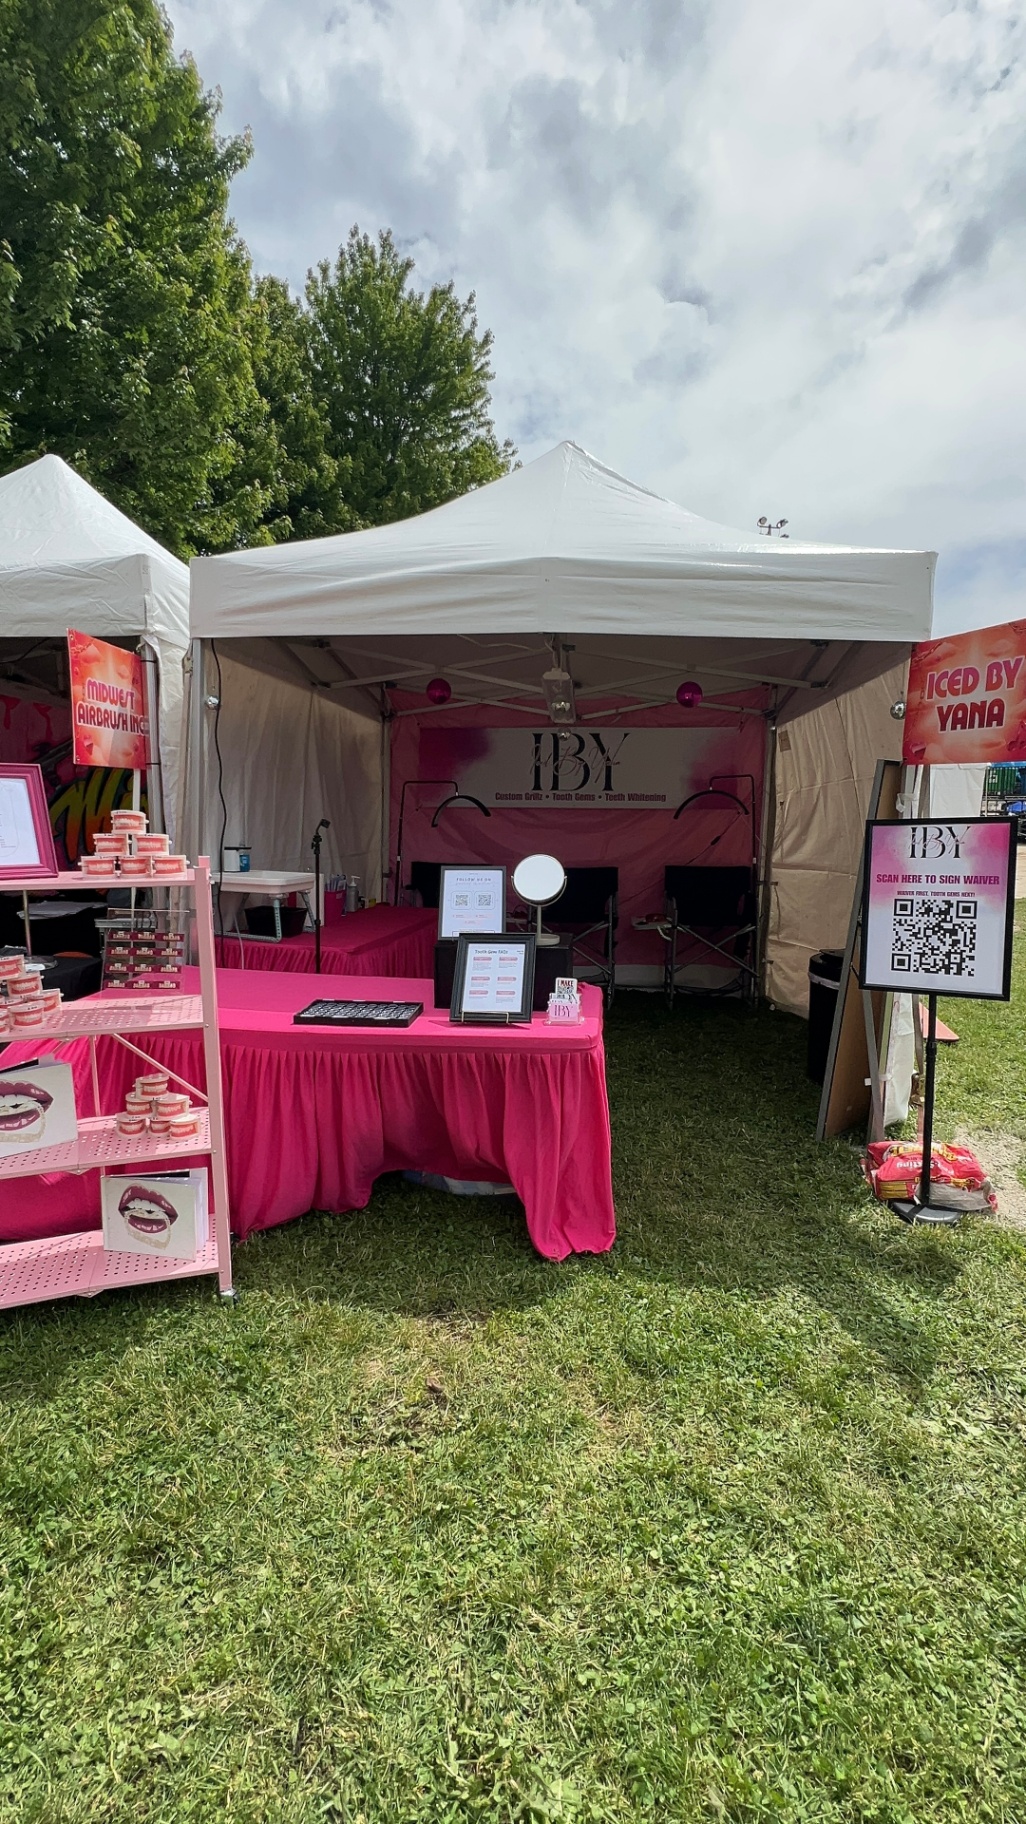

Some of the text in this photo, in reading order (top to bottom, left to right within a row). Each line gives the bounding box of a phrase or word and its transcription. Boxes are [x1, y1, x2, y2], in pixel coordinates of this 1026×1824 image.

[926, 657, 1024, 700] ICED BY
[87, 679, 135, 710] MIDWEST
[77, 702, 128, 732] AIRBRUSH
[936, 697, 1005, 732] YANA
[531, 732, 631, 792] IBY
[495, 792, 667, 802] Custom Grillz Tooth Gems Teeth Whitening
[909, 825, 971, 859] IBY
[876, 873, 1000, 885] SCAN HERE TO SIGN WAIVER
[554, 1004, 573, 1018] IBY
